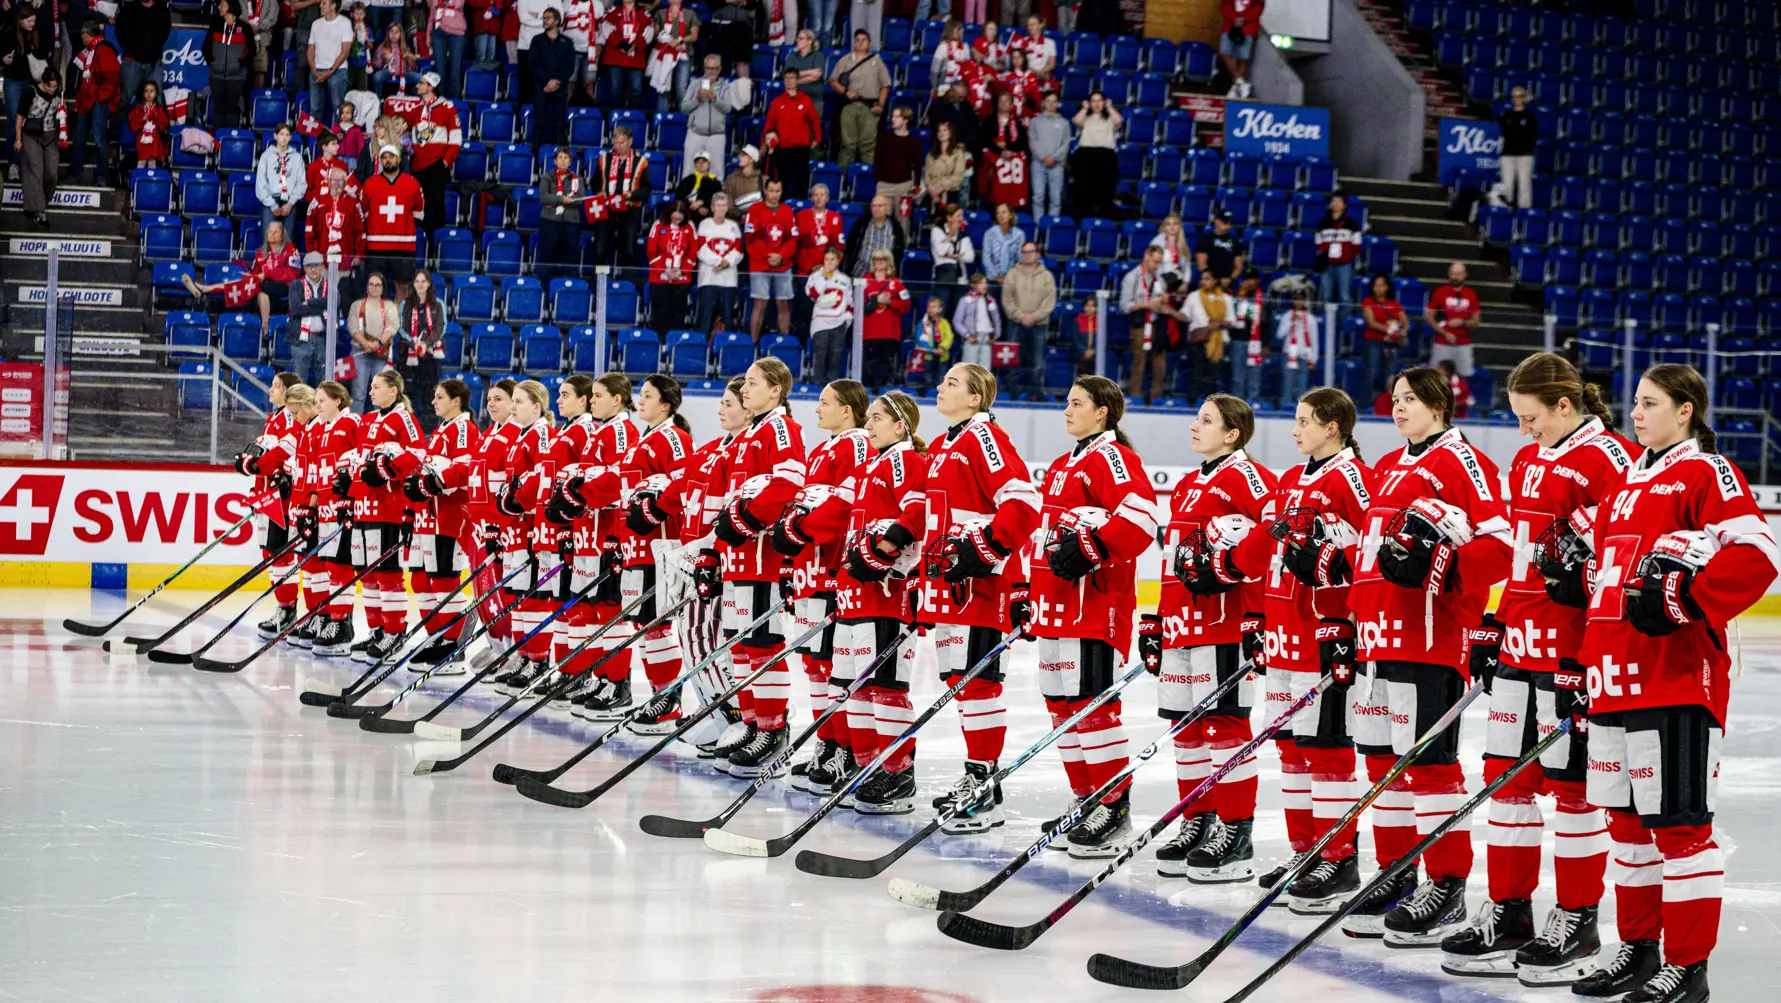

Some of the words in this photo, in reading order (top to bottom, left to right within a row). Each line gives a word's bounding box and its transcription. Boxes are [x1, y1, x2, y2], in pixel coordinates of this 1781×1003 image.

[1233, 108, 1320, 140] Kloten
[999, 158, 1024, 184] 28
[404, 415, 417, 439] TISSOT
[775, 420, 787, 446] TISSOT
[1434, 433, 1454, 447] SWISS
[1575, 427, 1595, 442] SWISS
[669, 431, 682, 457] TISSOT
[978, 428, 1001, 467] TISSOT
[1090, 436, 1106, 450] SWISS
[1671, 445, 1692, 460] SWISS
[1107, 448, 1126, 480] TISSOT
[1222, 455, 1237, 467] SWISS
[1327, 456, 1344, 468] SWISS
[1461, 448, 1488, 497] TISSOT
[1049, 471, 1068, 496] 68
[1347, 467, 1370, 504] TISSOT
[1379, 470, 1406, 495] 77
[1522, 464, 1544, 499] 82
[354, 496, 378, 520] pt:
[1179, 489, 1202, 512] 72
[1610, 489, 1641, 522] 94
[72, 489, 254, 546] SWIS
[532, 522, 555, 550] pt:
[621, 536, 646, 565] pt:
[720, 546, 745, 578] pt:
[917, 580, 949, 614] pt:
[1030, 594, 1064, 627] pt:
[1666, 571, 1689, 624] BAUER
[1264, 625, 1300, 663] pt:
[940, 675, 970, 706] BAUER
[1164, 673, 1192, 684] SWISS
[1588, 655, 1641, 708] pt:
[1206, 685, 1228, 705] BAUER
[1266, 692, 1292, 702] SWISS
[1358, 706, 1389, 717] SWISS
[1489, 710, 1517, 723] SWISS
[754, 745, 795, 790] BAUER
[1198, 740, 1259, 798] JETSPEED
[1591, 761, 1621, 772] SWISS
[1629, 767, 1653, 779] SWISS
[937, 777, 995, 826] CCM
[1028, 808, 1083, 858] BAUER
[1092, 829, 1152, 888] CCM
